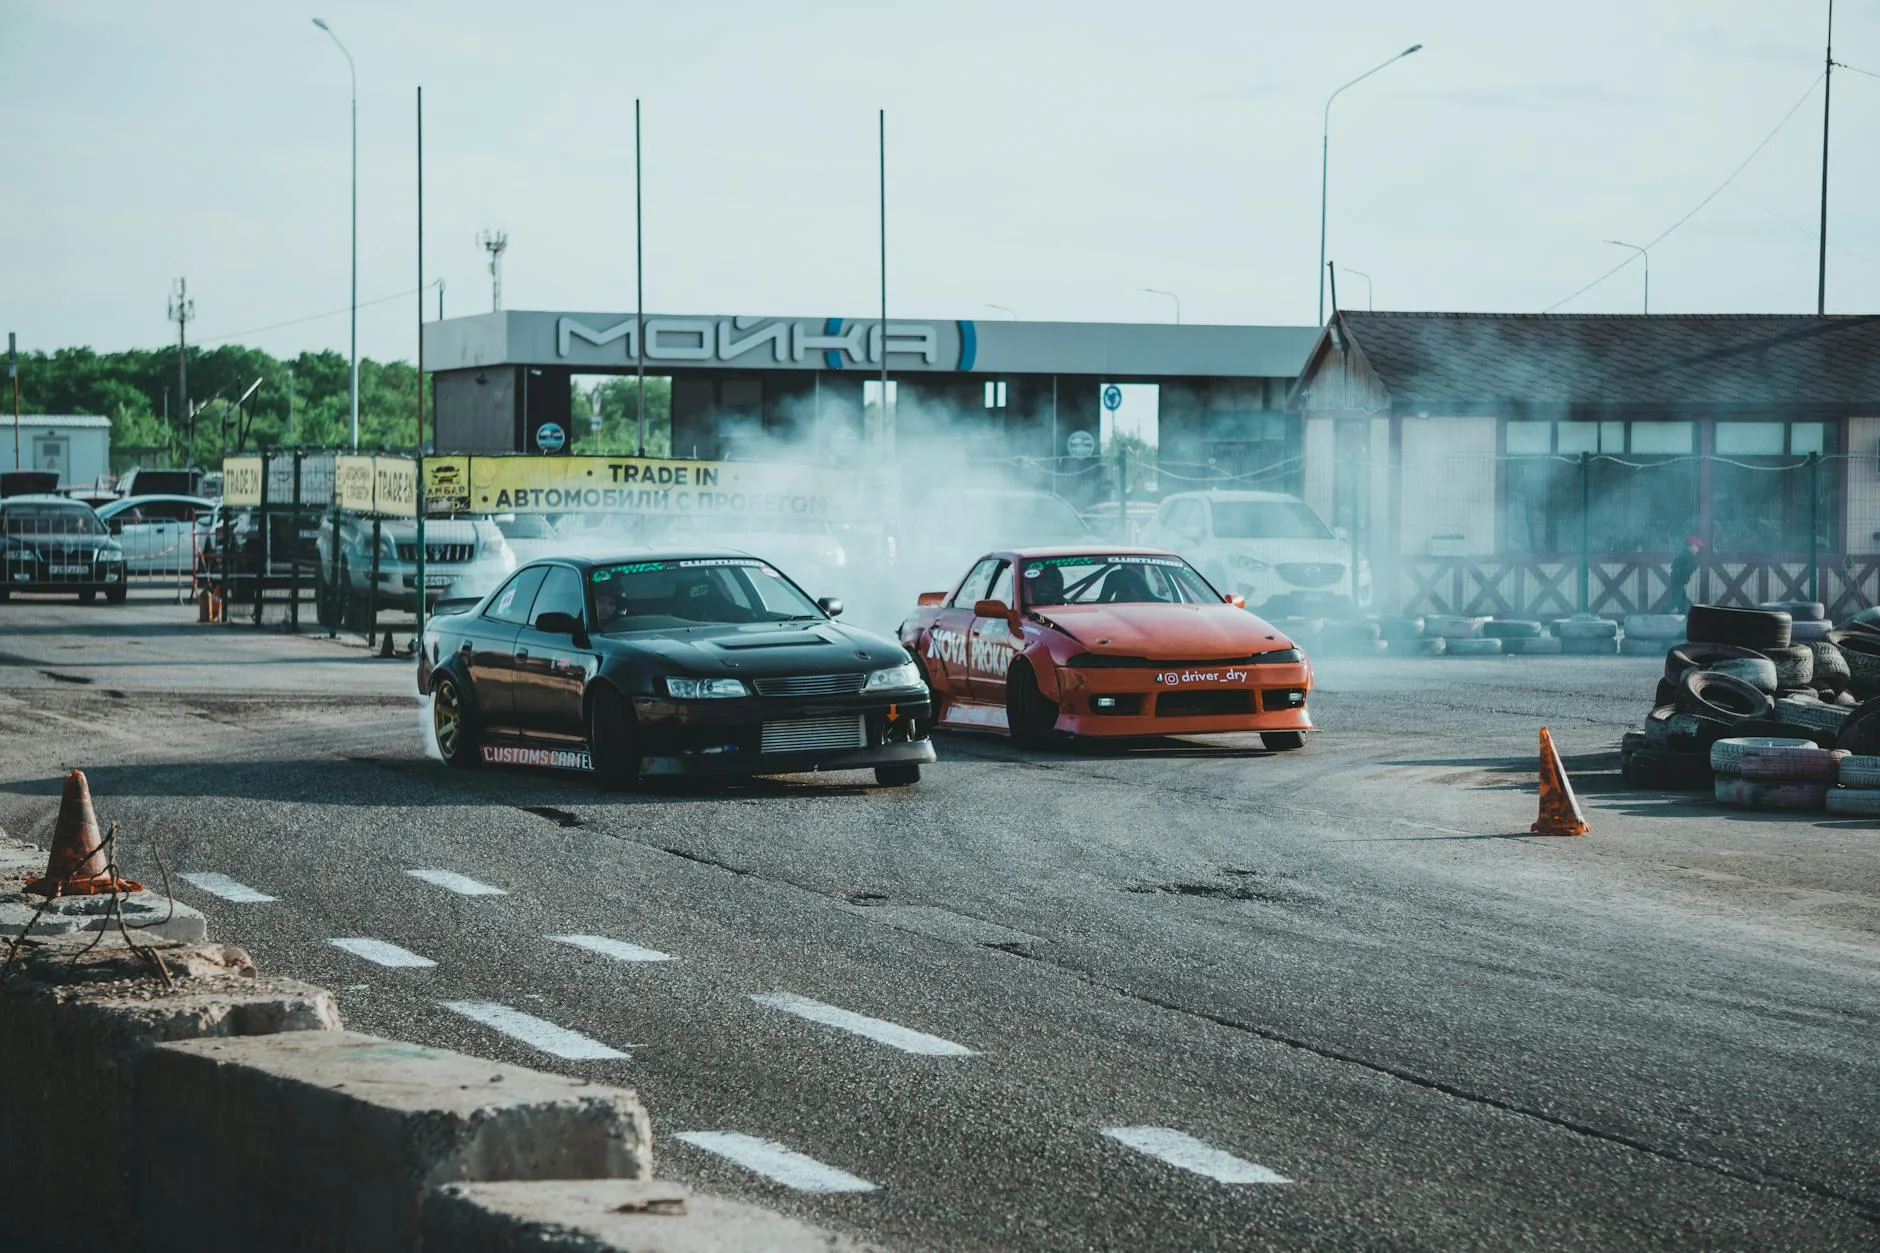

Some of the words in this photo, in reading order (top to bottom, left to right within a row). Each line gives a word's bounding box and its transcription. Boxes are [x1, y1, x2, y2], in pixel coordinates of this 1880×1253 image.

[557, 315, 938, 364] МОЙКА
[608, 463, 688, 485] TRADE
[695, 467, 718, 486] IN
[496, 488, 668, 509] АВТОМОБИЛИ
[676, 491, 690, 510] С
[927, 629, 968, 668] NOVA
[1181, 668, 1248, 683] driver_dry
[483, 746, 548, 765] CUSTOMS
[550, 750, 595, 770] CARTEL
